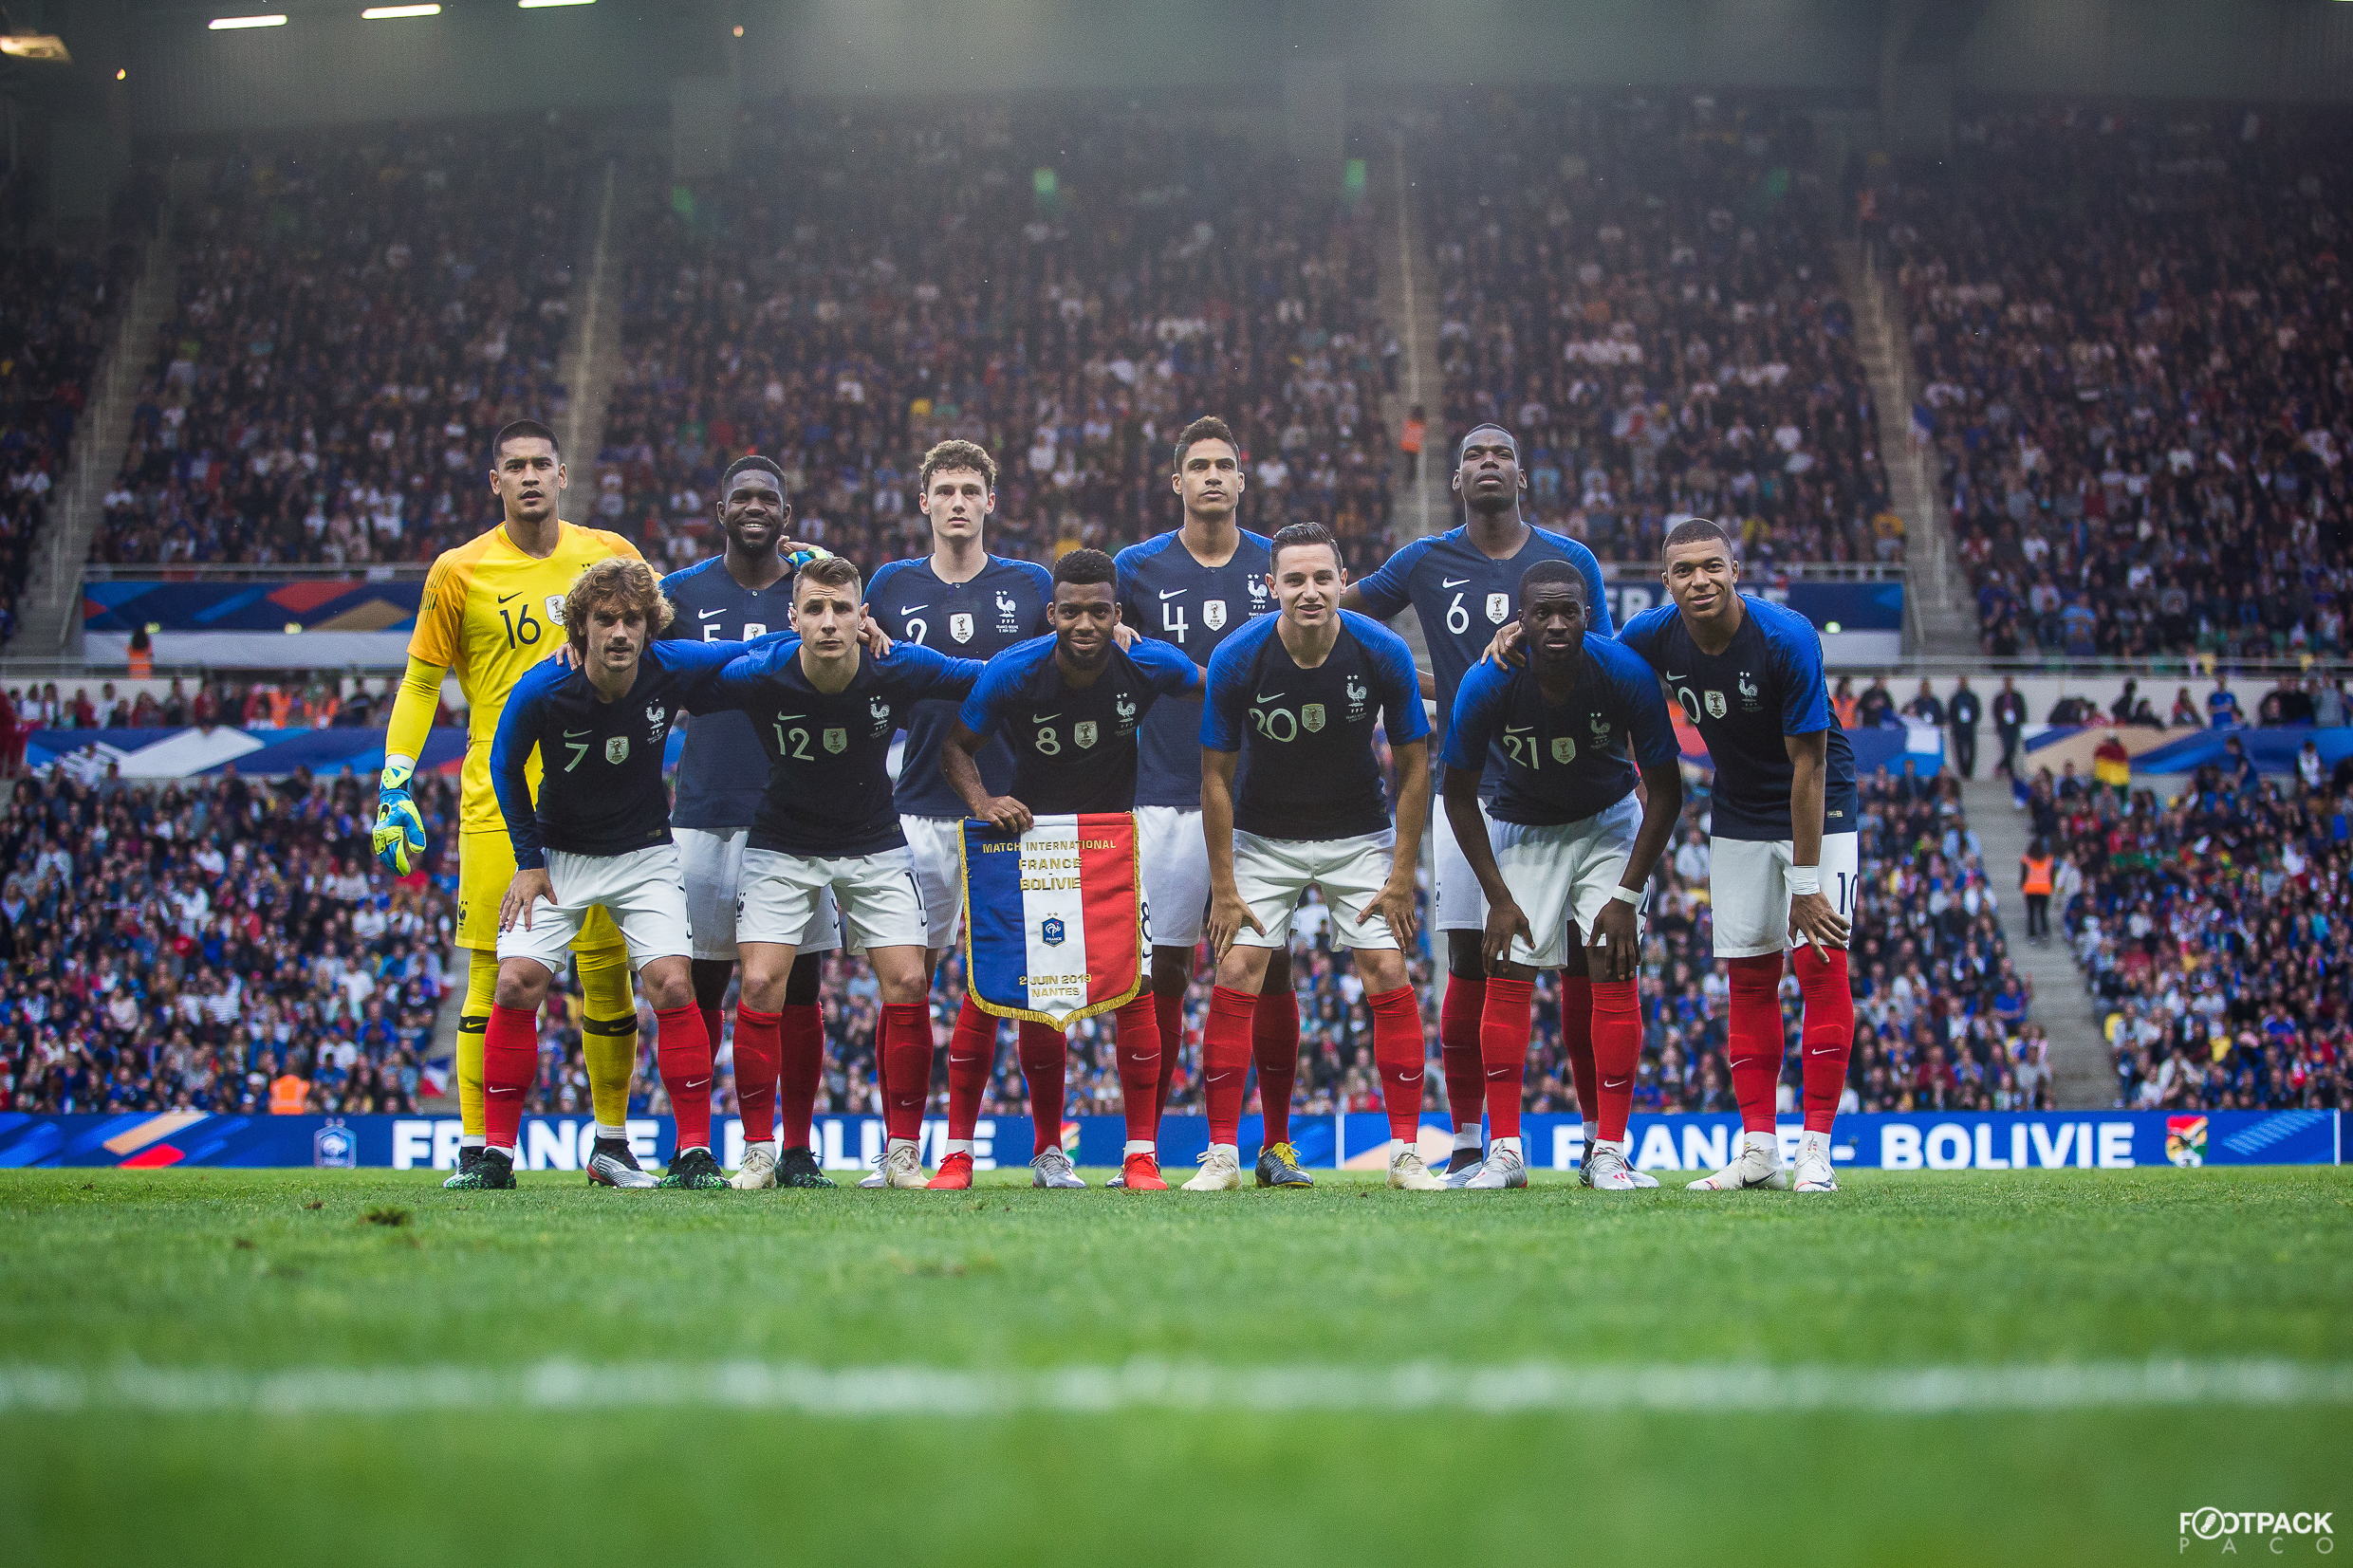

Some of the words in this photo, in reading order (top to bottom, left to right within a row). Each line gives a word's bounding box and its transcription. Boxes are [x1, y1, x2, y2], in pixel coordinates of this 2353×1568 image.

[499, 603, 541, 650] 16
[1162, 601, 1189, 643] 4
[1446, 592, 1470, 635] 6
[905, 618, 928, 645] 2
[772, 722, 815, 762] 12
[1035, 727, 1062, 756] 8
[1248, 708, 1297, 743] 20
[564, 742, 589, 773] 7
[1502, 734, 1540, 770] 21
[982, 841, 1021, 854] MATCH
[1026, 839, 1117, 852] INTERNATIONAL
[1018, 857, 1083, 871] FRANCE
[904, 871, 927, 911] 1
[1019, 876, 1082, 891] BOLIVIE
[1018, 975, 1028, 986] 2
[1029, 975, 1059, 986] JUIN
[1061, 973, 1092, 985] 2019
[1031, 987, 1081, 998] NANTES
[1552, 1124, 1805, 1171] FANE
[1880, 1122, 2136, 1171] BOLIVIE
